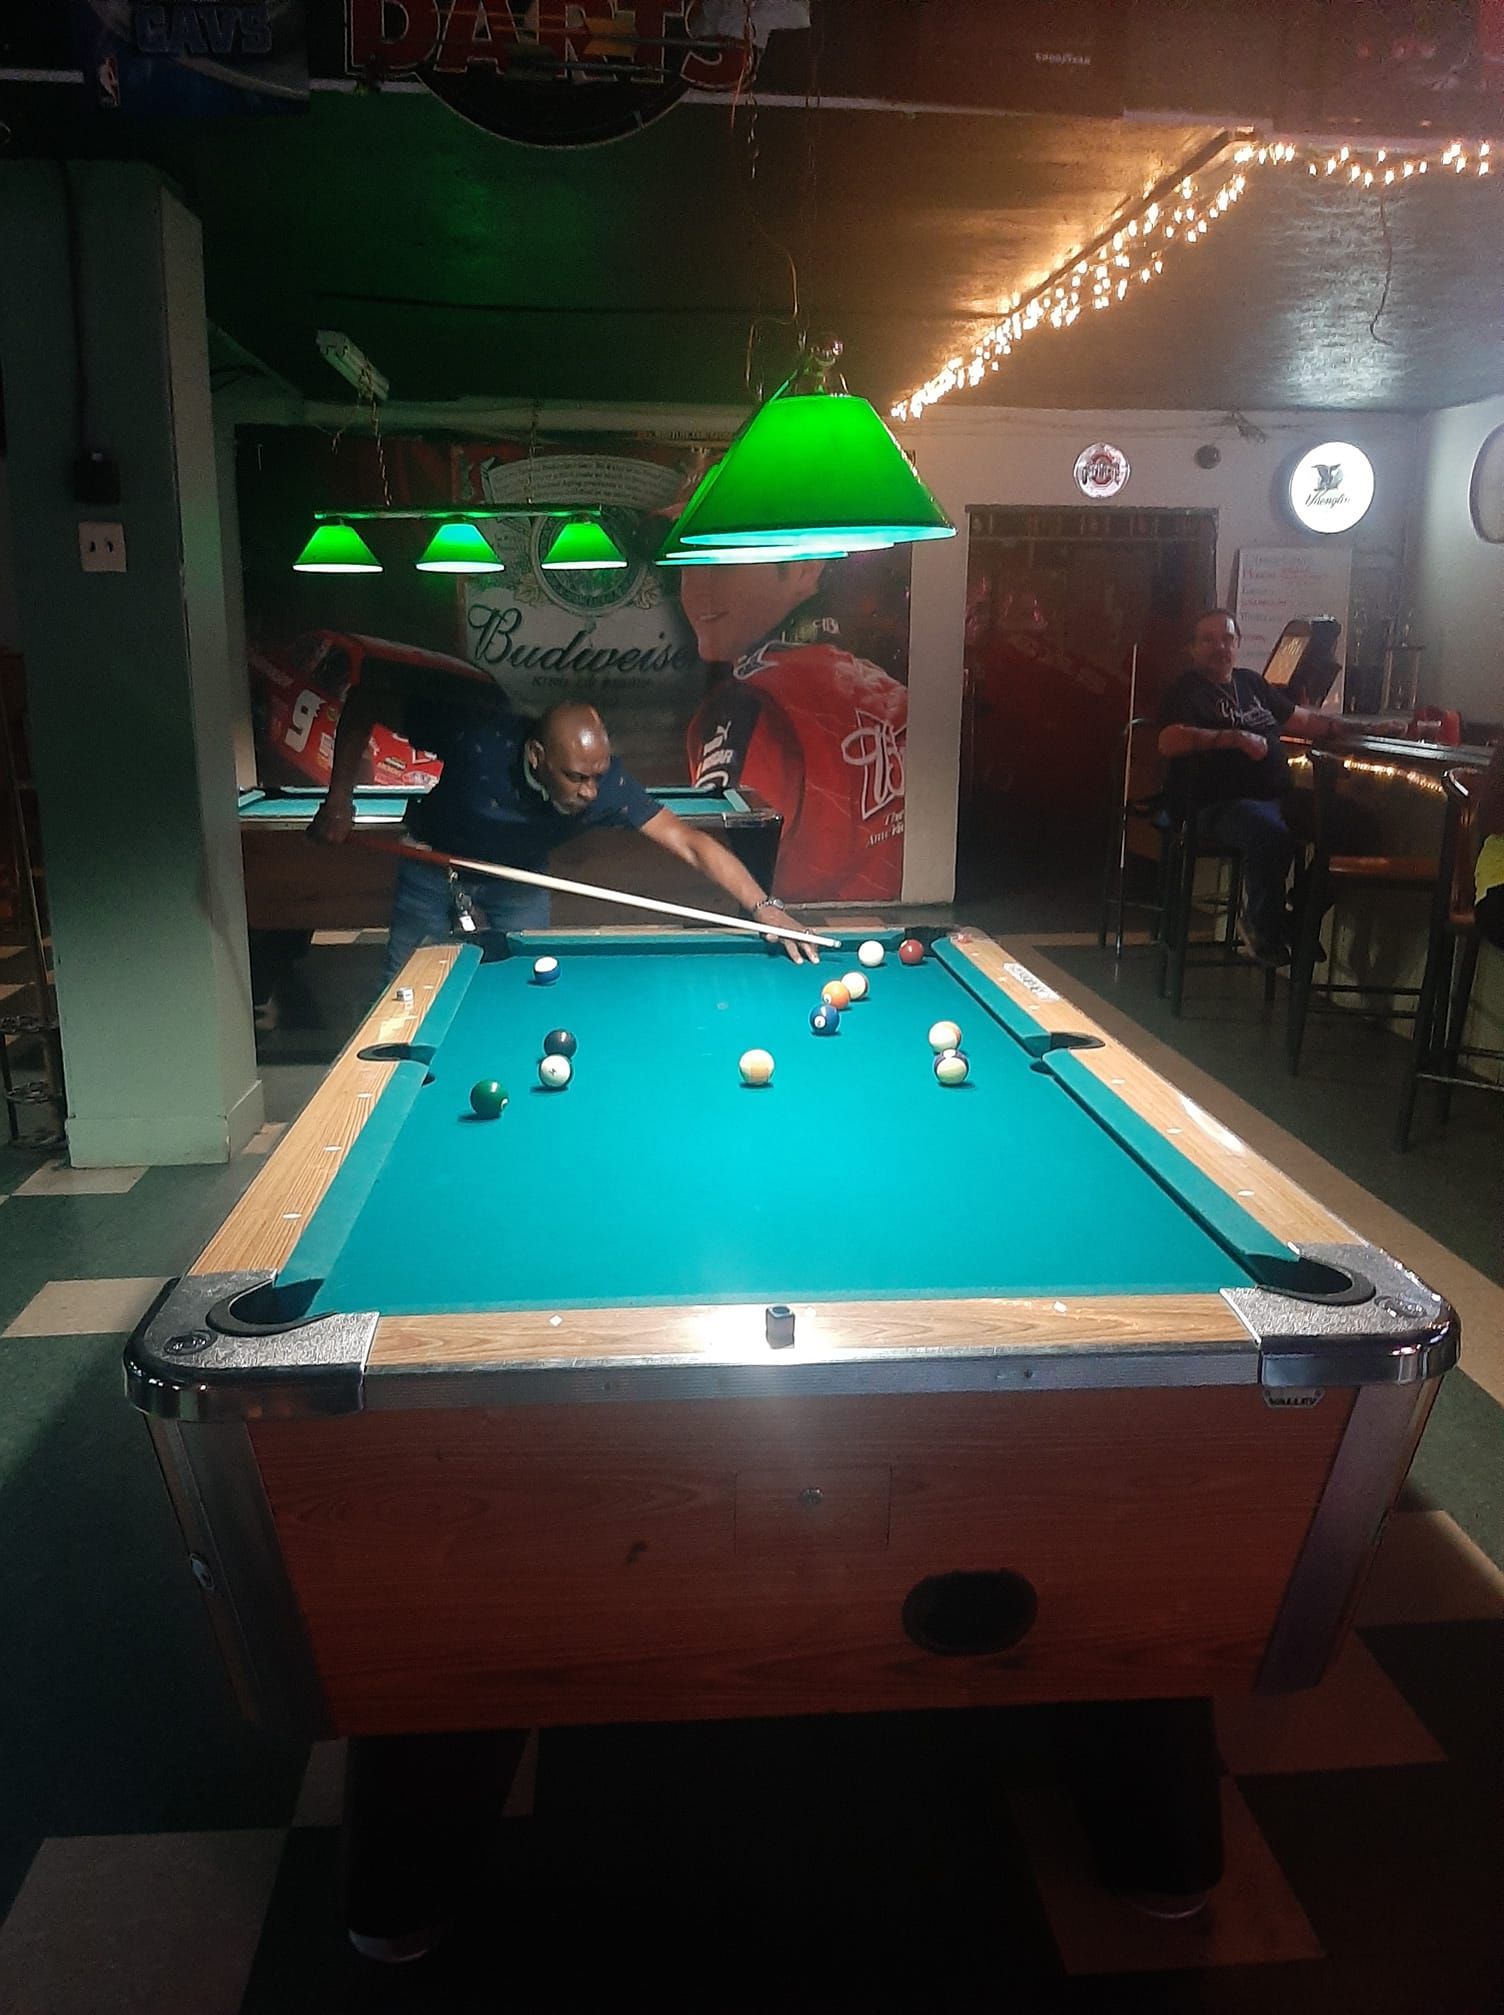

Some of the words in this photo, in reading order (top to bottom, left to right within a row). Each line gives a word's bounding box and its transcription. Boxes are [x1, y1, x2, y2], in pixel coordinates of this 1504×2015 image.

[134, 6, 272, 53] CAVS
[343, 0, 758, 94] DARTS
[467, 603, 690, 672] Budweise
